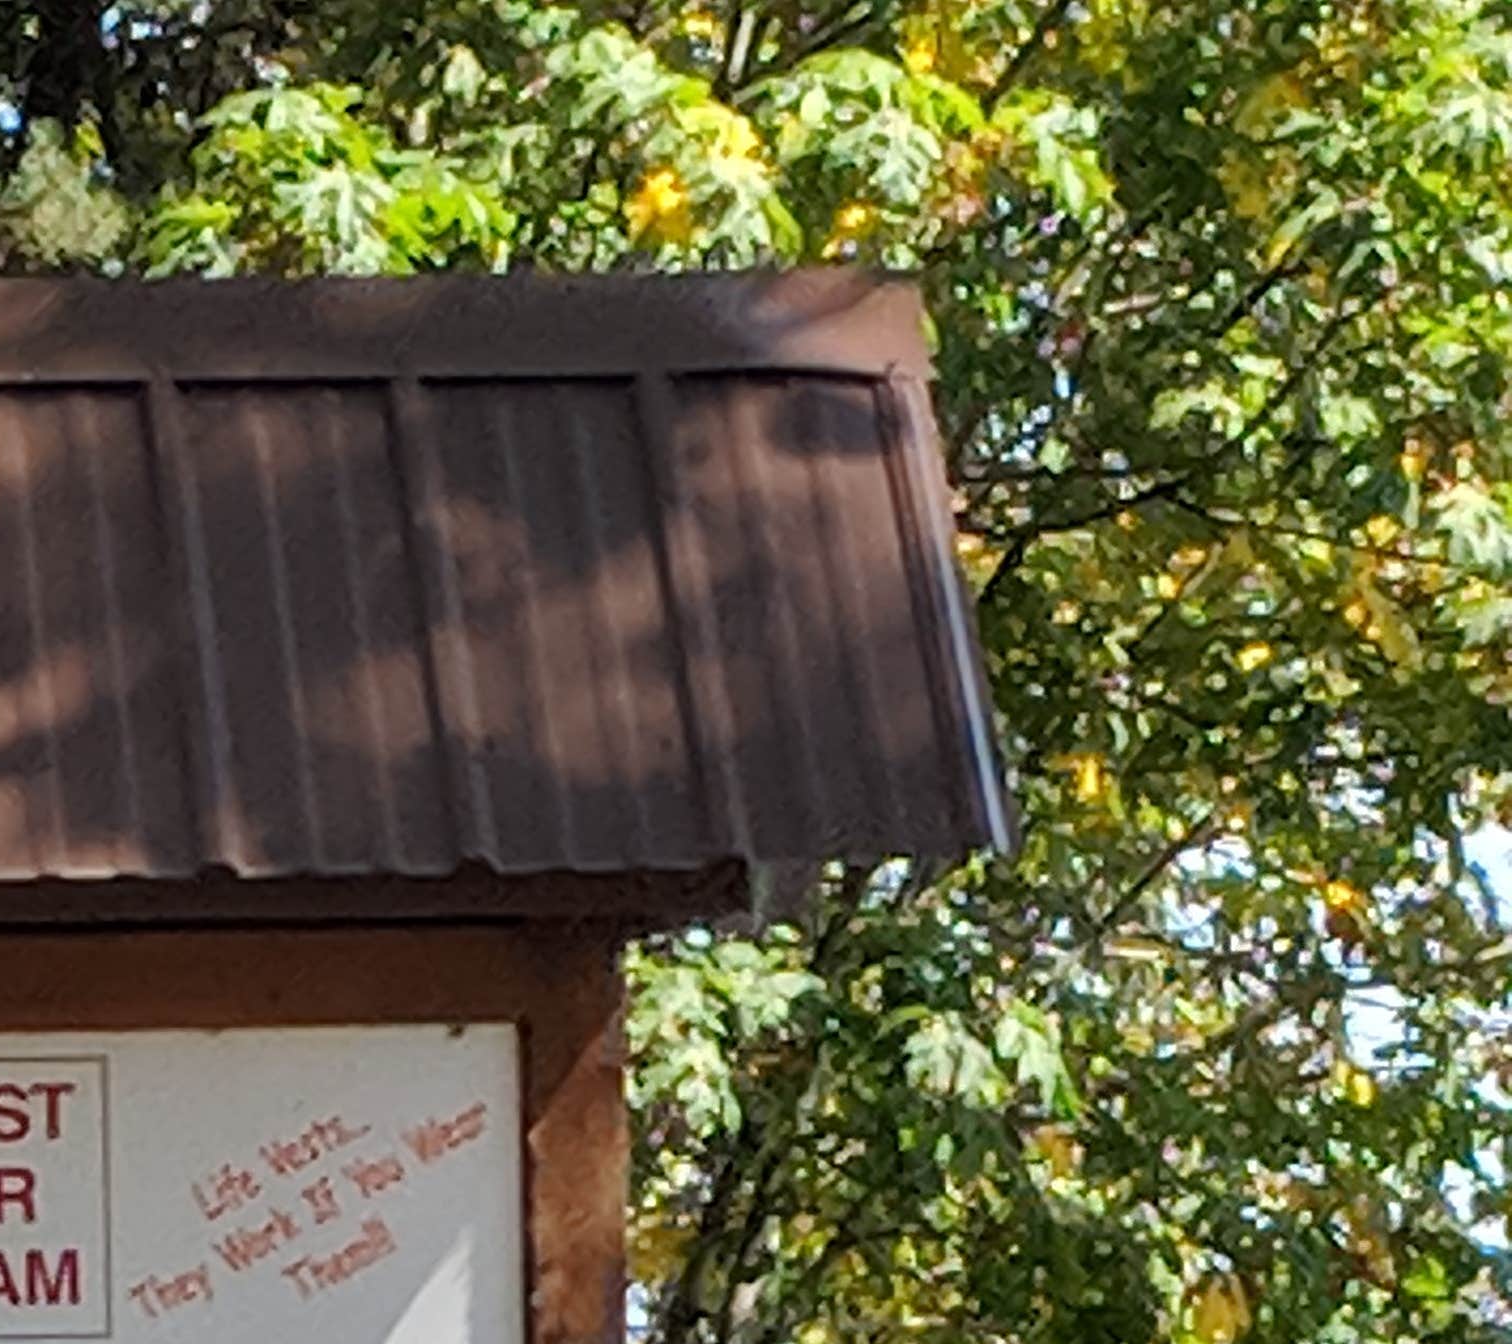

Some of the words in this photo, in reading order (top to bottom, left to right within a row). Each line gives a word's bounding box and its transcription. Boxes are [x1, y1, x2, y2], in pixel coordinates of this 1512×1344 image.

[128, 1263, 215, 1319] They
[209, 1207, 304, 1272] Work
[340, 1156, 407, 1199] You
[191, 1163, 263, 1221] Life
